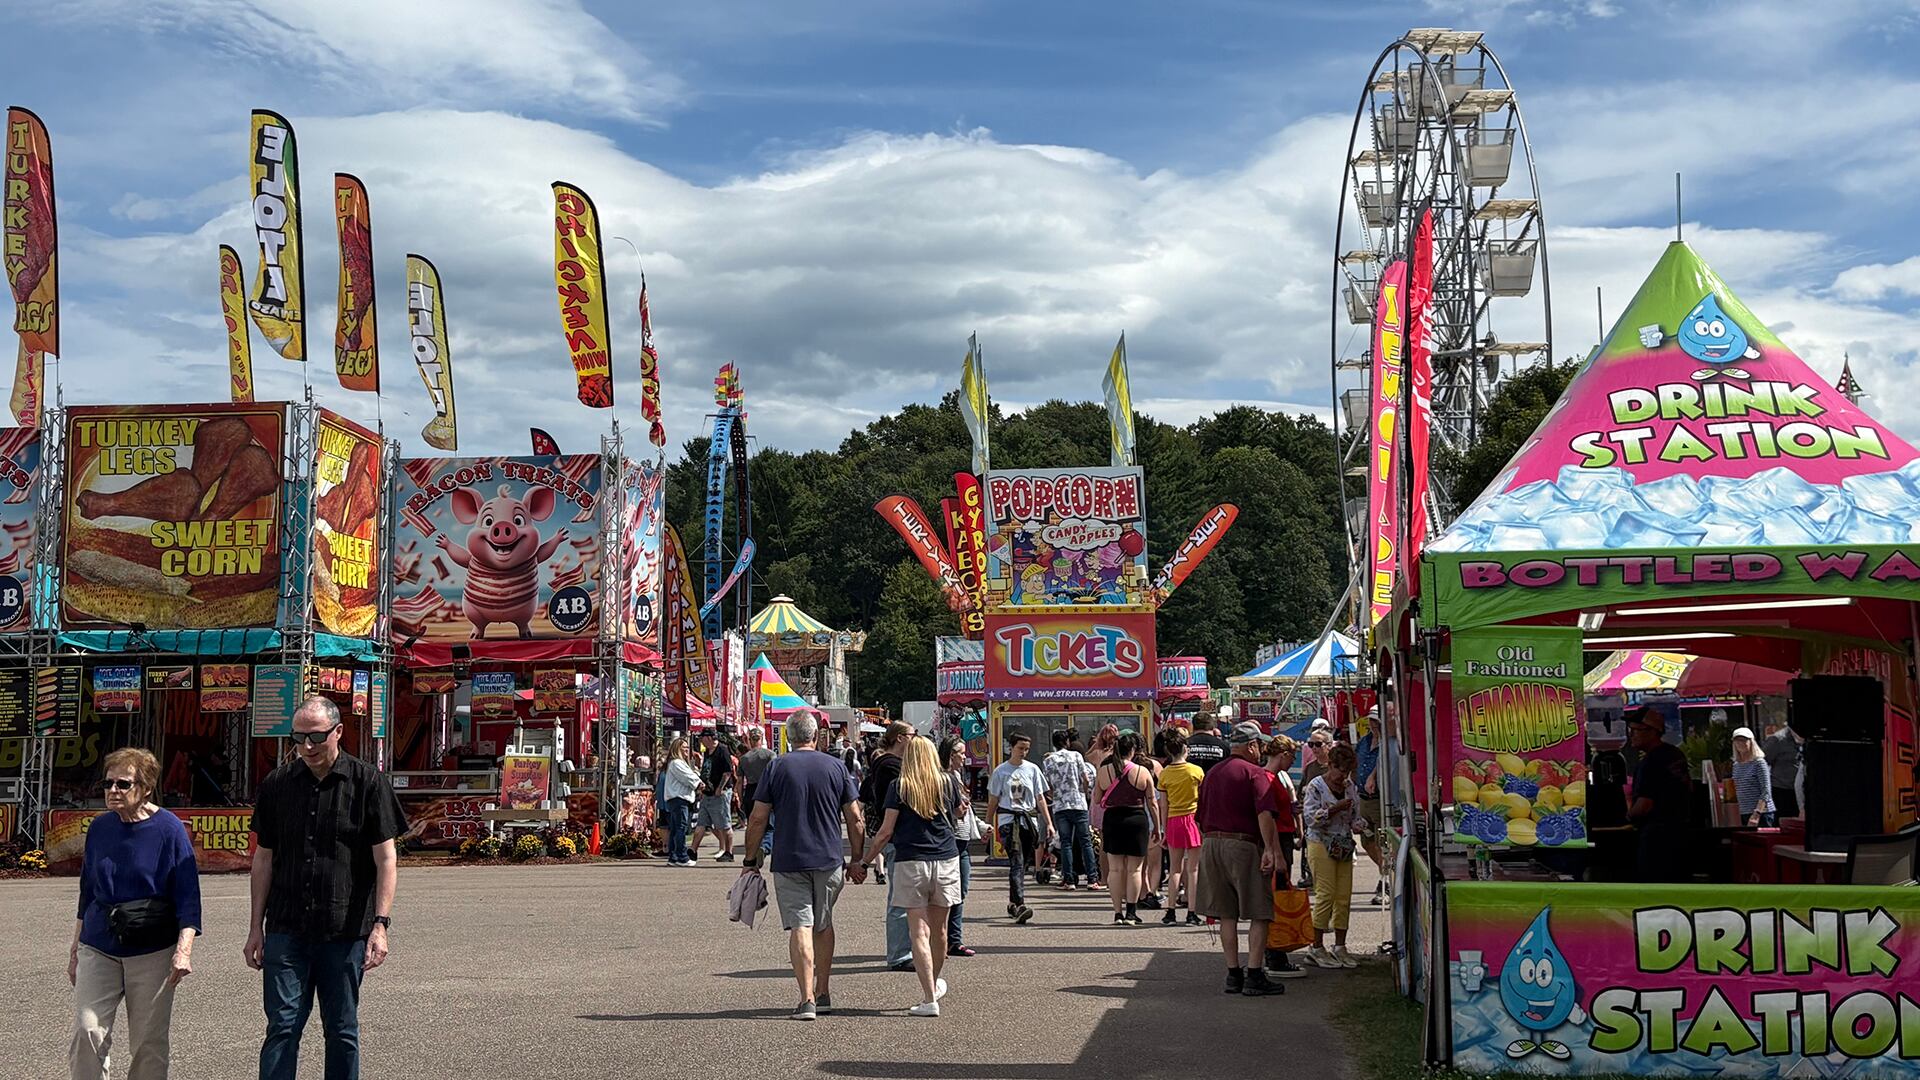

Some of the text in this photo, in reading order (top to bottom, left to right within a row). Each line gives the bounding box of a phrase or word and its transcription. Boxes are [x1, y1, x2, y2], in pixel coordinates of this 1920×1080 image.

[4, 121, 31, 293] TURKEY
[1607, 380, 1827, 425] DRINK
[76, 418, 199, 447] TURKEY
[319, 423, 359, 462] TURKEY
[1569, 420, 1890, 469] STATION
[99, 447, 178, 475] LEGS
[322, 455, 344, 485] LEGS
[406, 462, 493, 514] BACON
[500, 461, 595, 510] TREATS
[990, 474, 1140, 522] POPCORN
[150, 519, 274, 548] SWEET
[964, 484, 988, 596] GYROS
[1048, 524, 1088, 540] CANDY
[1070, 528, 1116, 545] APPLES
[161, 547, 262, 576] CORN
[329, 530, 373, 565] SWEET
[893, 501, 965, 597] TERIYAKI
[331, 557, 369, 590] CORN
[1459, 552, 1782, 590] BOTTLED
[555, 597, 587, 615] AB
[636, 604, 650, 622] AB
[667, 553, 680, 667] MAPLE
[996, 623, 1144, 678] TICKETS
[1496, 646, 1533, 661] Old
[950, 670, 985, 690] DRINKS
[1161, 666, 1188, 686] COLD
[1464, 660, 1566, 678] Fashioned
[1032, 688, 1108, 699] WWW.STRATES.COM
[1457, 682, 1580, 755] LEMONADE
[513, 758, 542, 770] Turkey
[189, 815, 251, 833] TURKE
[203, 833, 249, 850] LEGS
[1632, 905, 1902, 978] DRINK
